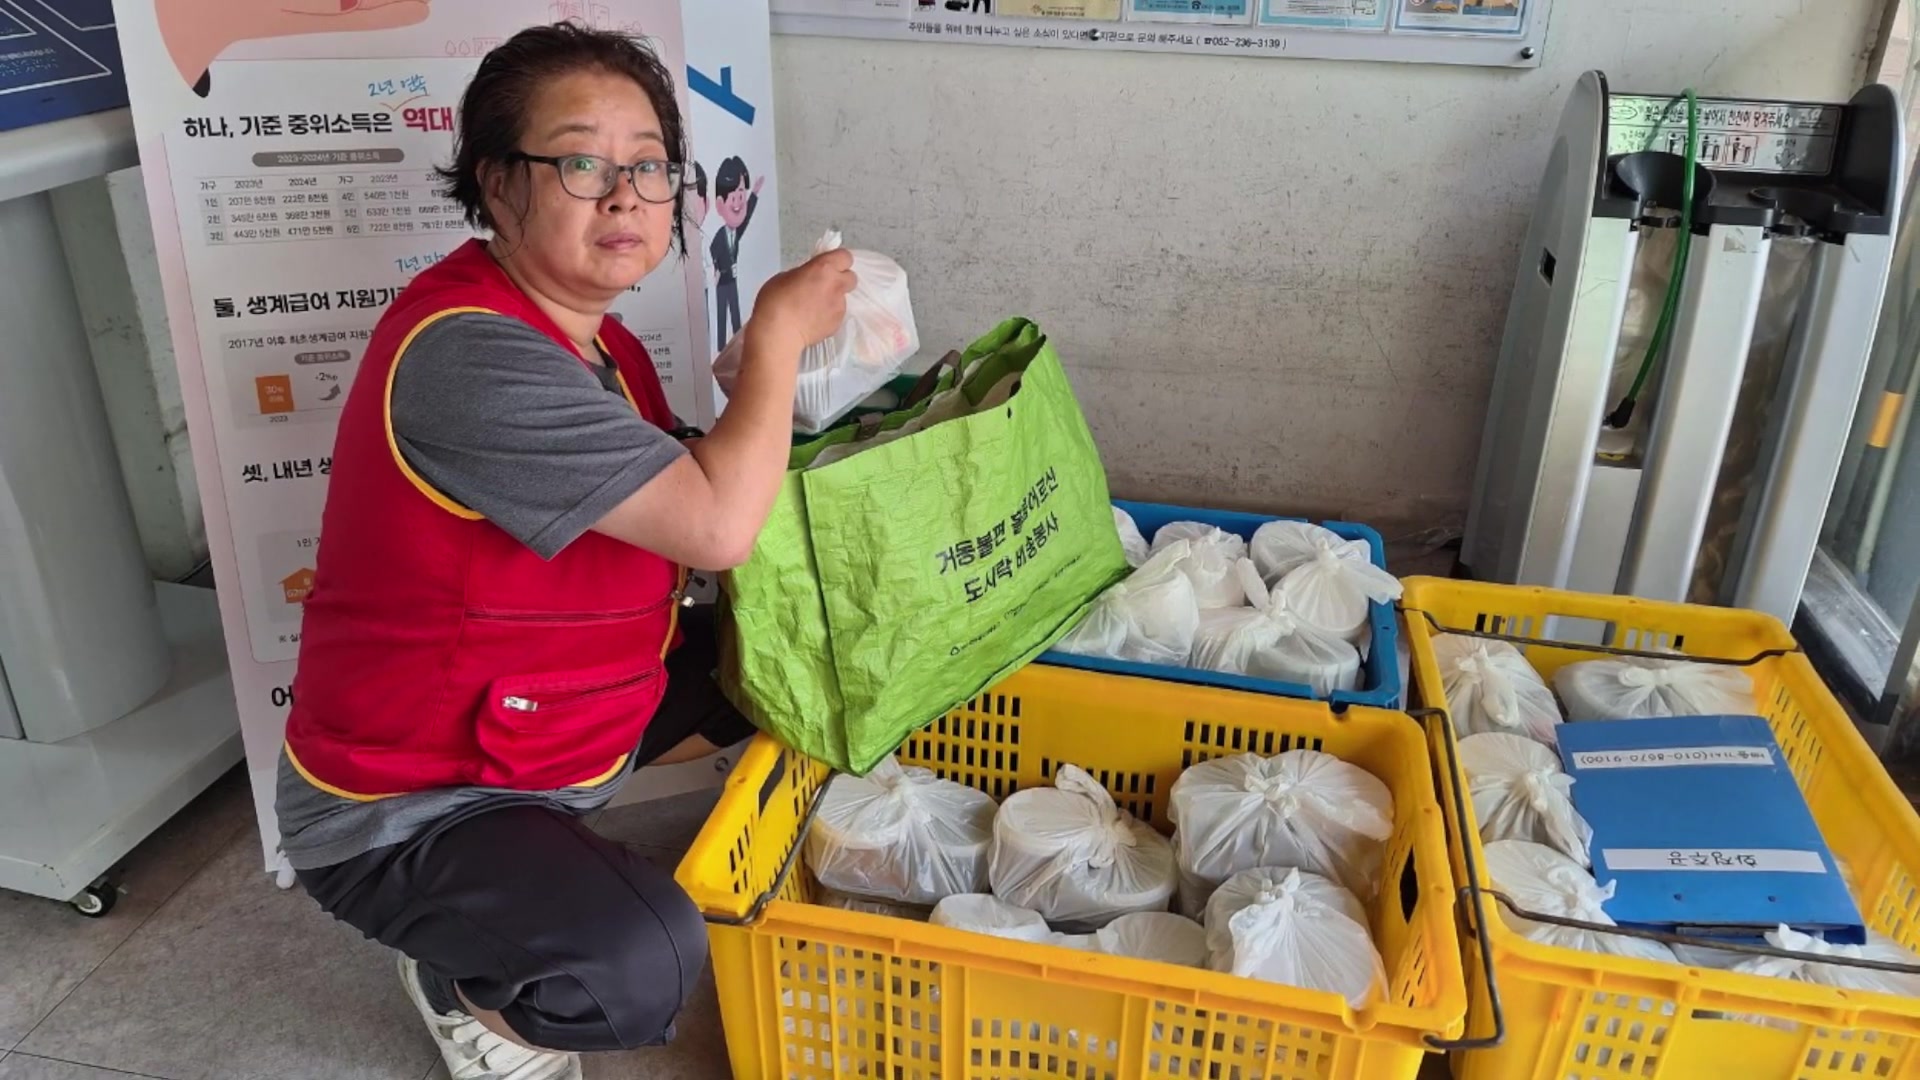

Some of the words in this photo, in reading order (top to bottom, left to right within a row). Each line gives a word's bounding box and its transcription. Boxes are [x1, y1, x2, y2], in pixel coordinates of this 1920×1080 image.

[369, 79, 397, 97] 2년
[184, 116, 235, 138] 하나,
[239, 115, 283, 136] 기준
[288, 112, 393, 136] 중위소득은
[402, 106, 455, 133] 역대
[213, 295, 242, 319] 둘,
[247, 293, 331, 316] 생계급여
[228, 338, 265, 349] 2017년
[266, 335, 287, 347] 이후
[273, 458, 313, 480] 내년
[935, 519, 1007, 575] 거동불편
[964, 555, 1013, 604] 도시락
[1015, 510, 1060, 569] 배송봉사
[1667, 851, 1759, 867] 화정주공
